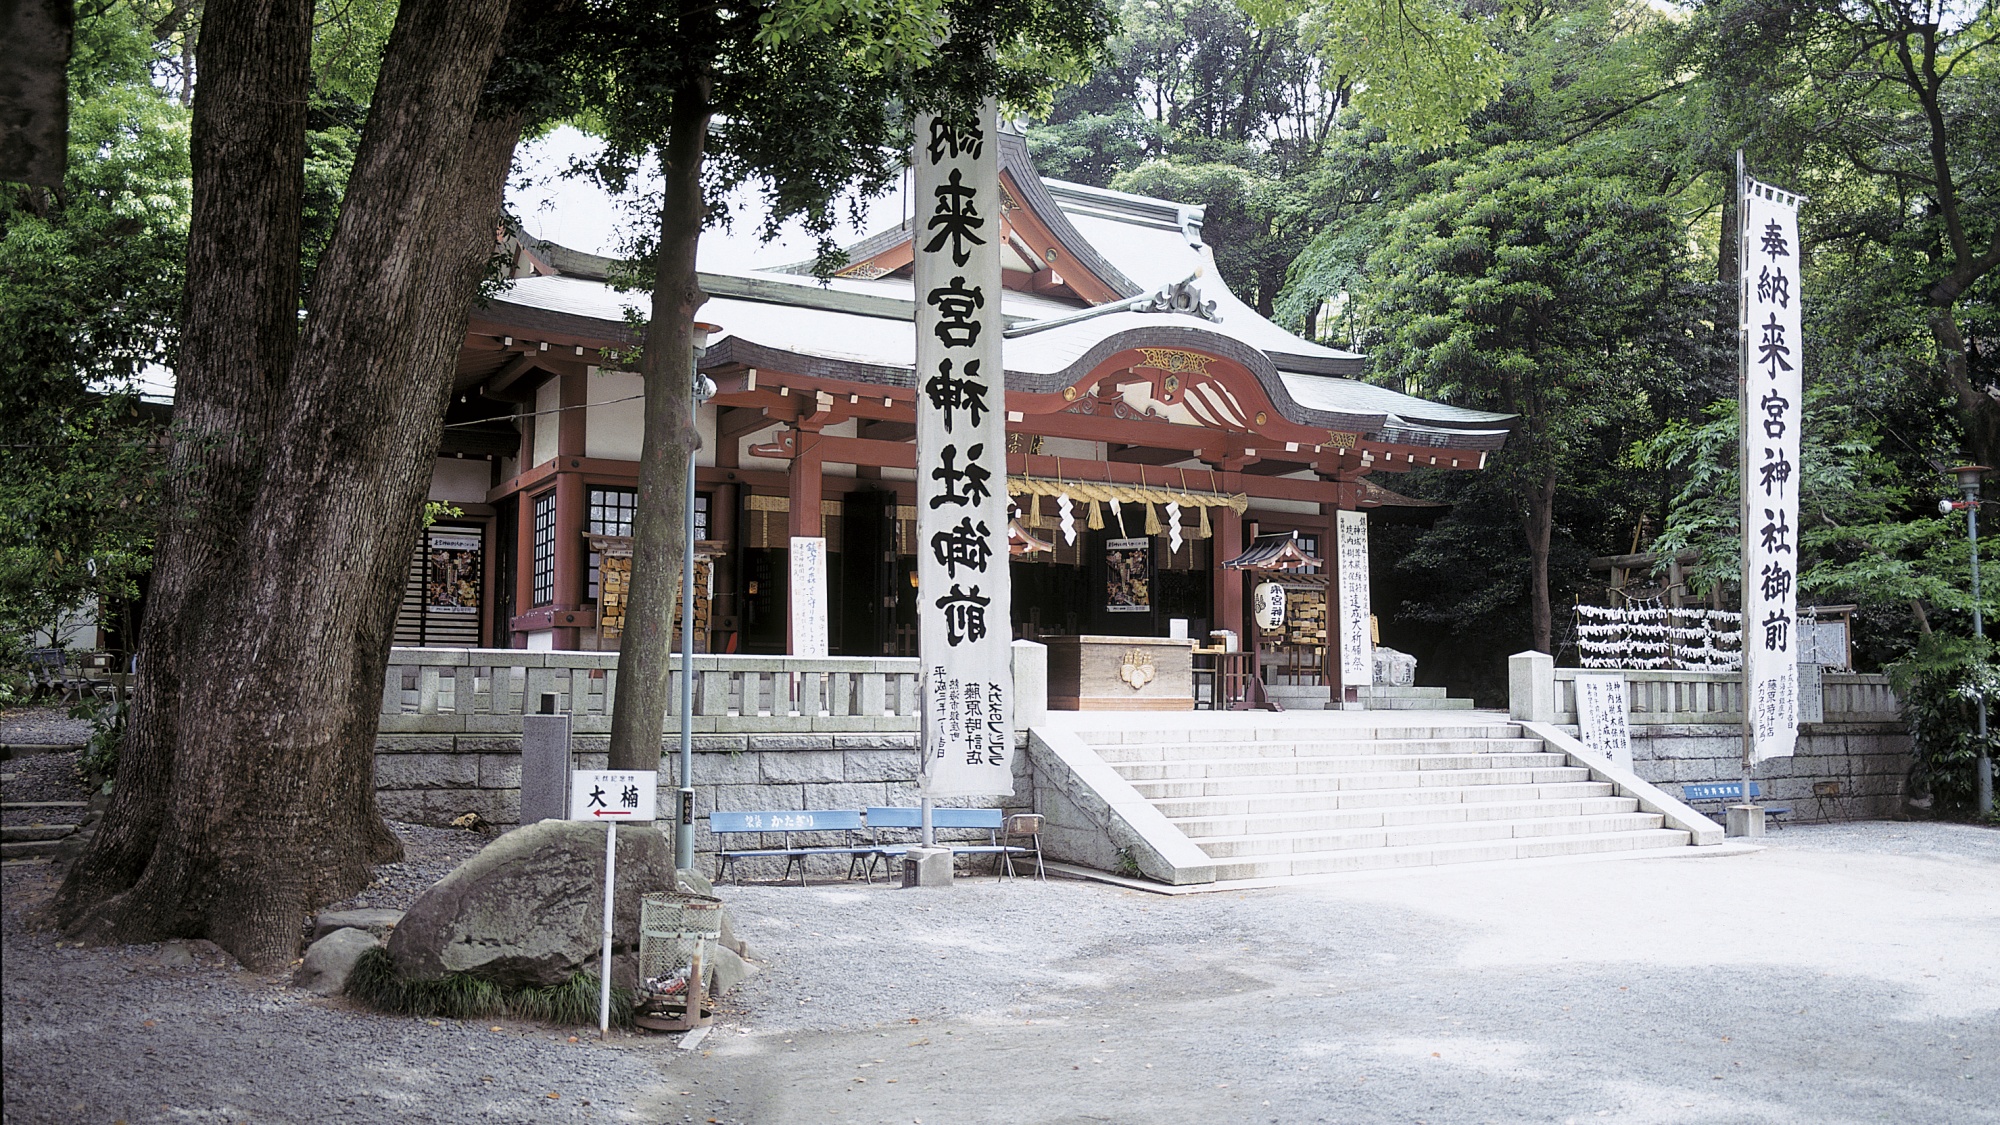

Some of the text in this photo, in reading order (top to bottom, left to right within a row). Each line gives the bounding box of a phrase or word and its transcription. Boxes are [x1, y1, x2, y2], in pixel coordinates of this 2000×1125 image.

[1757, 217, 1794, 654] 奉納来宮神社御前
[594, 775, 635, 783] 天然記念物
[587, 784, 640, 809] 大楠
